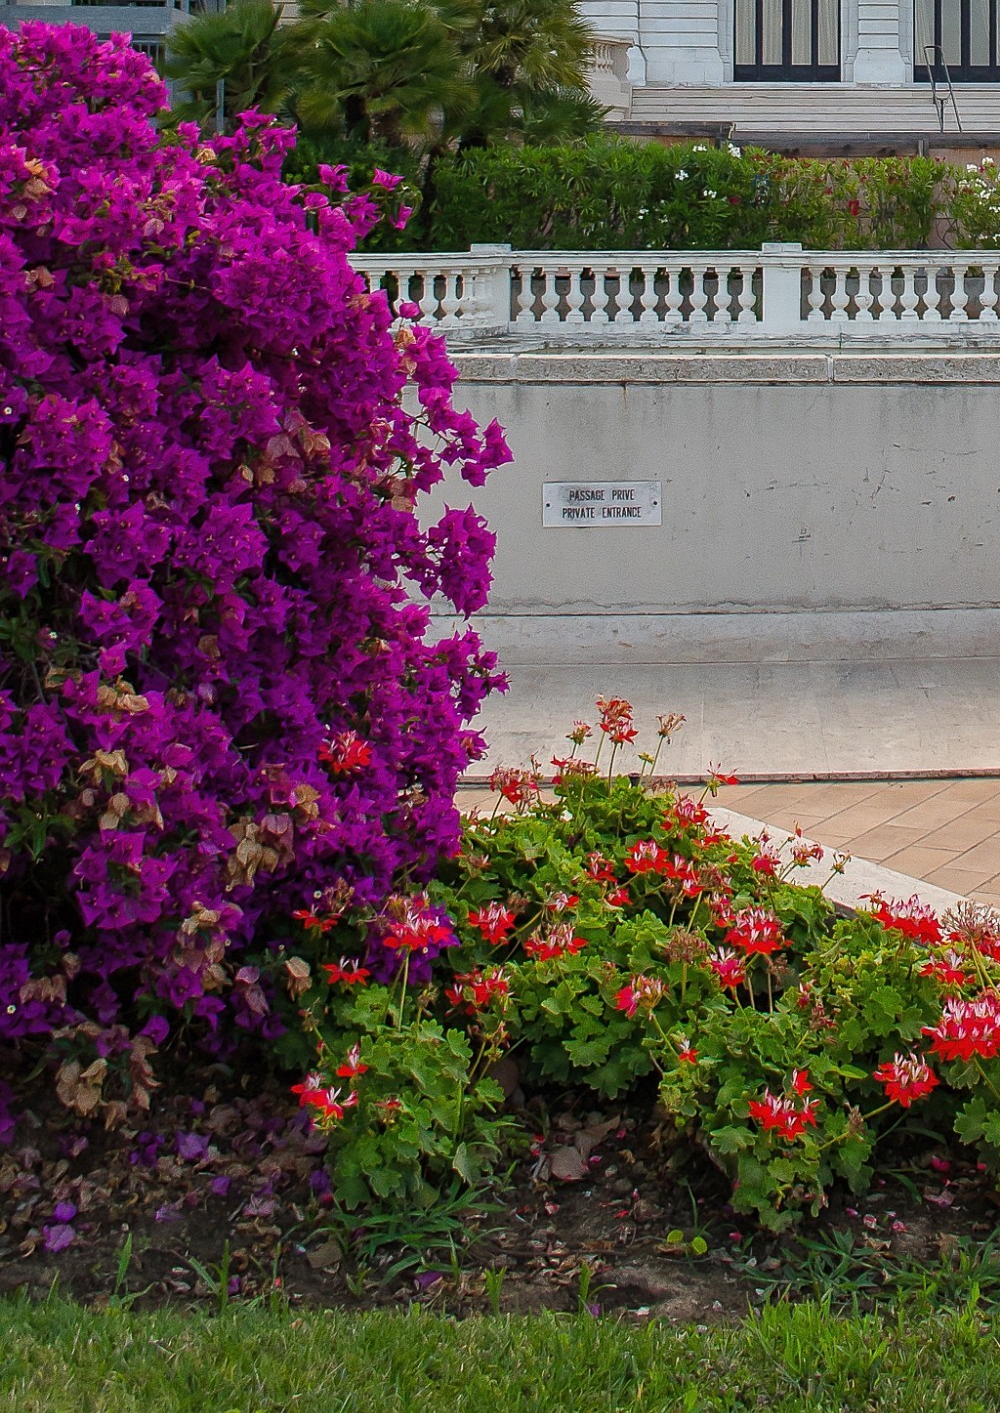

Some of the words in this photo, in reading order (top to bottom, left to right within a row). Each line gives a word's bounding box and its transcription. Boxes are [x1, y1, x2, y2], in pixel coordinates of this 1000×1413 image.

[570, 490, 605, 501] PASSAGE
[612, 489, 635, 500] PRIVE
[562, 507, 595, 519] PRIVATE
[602, 506, 642, 518] ENTRANCE
